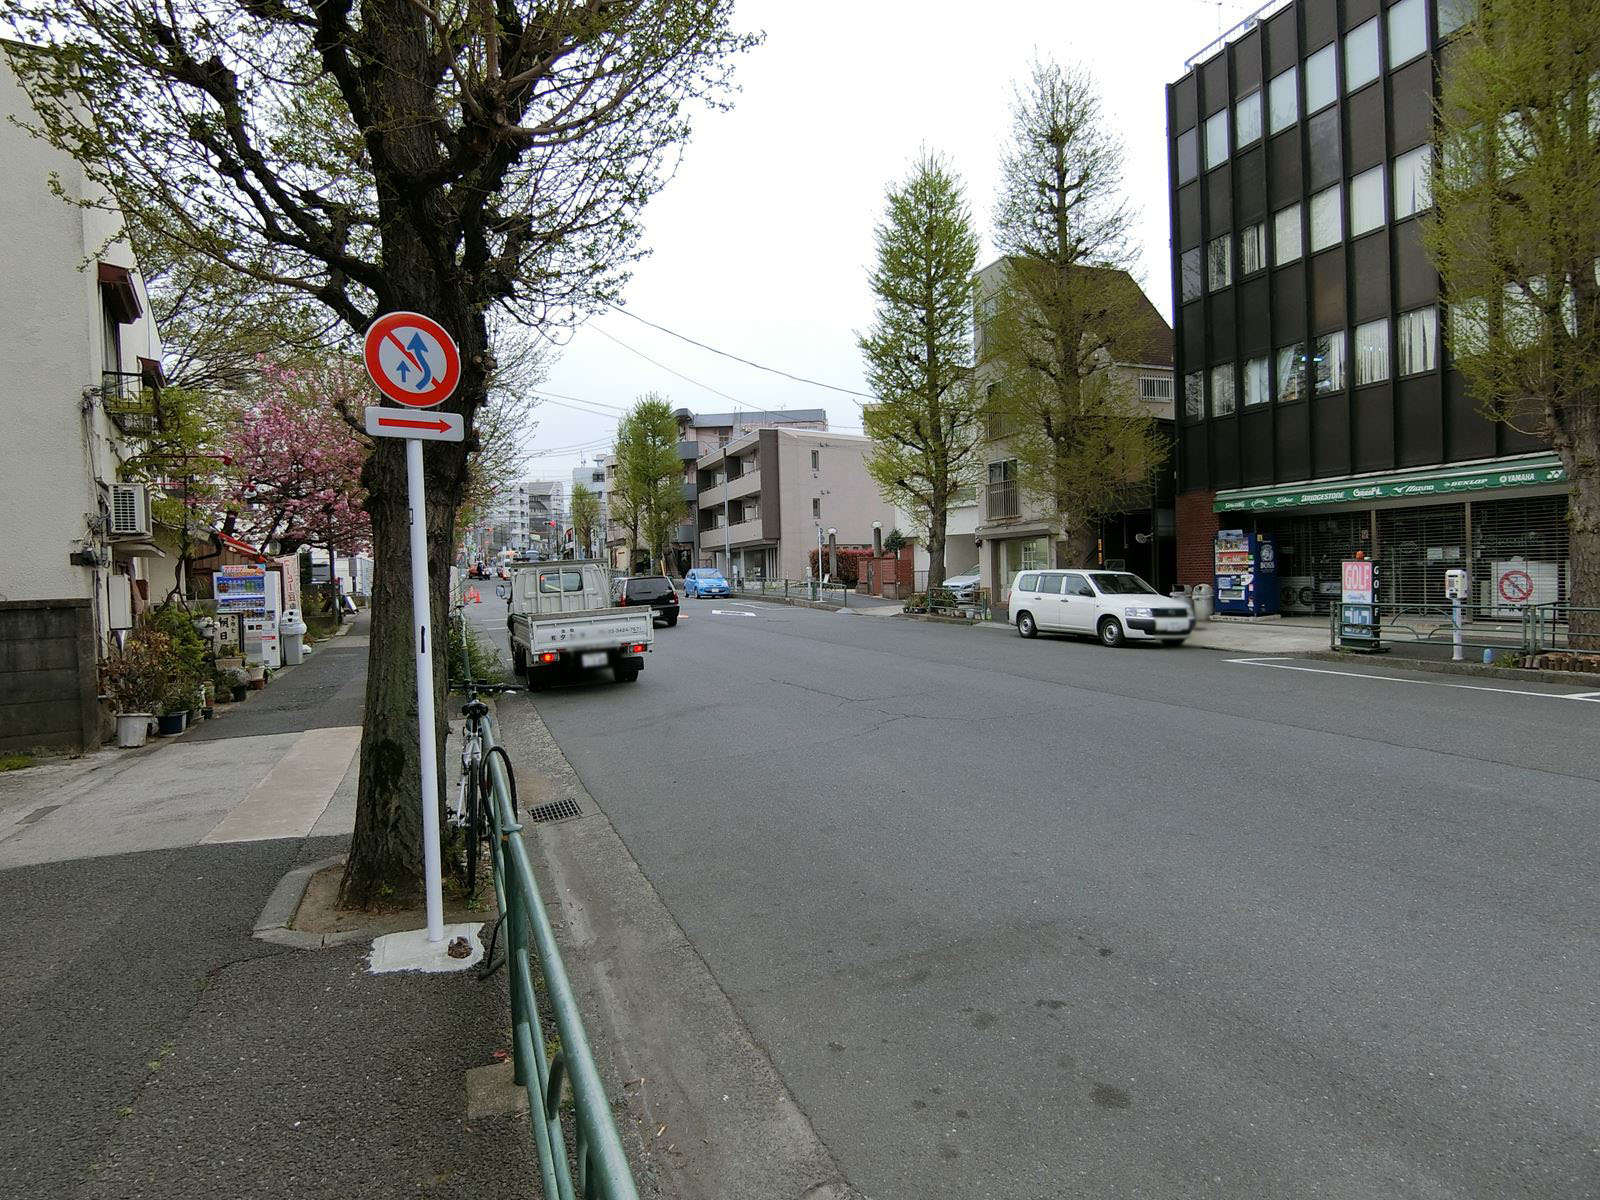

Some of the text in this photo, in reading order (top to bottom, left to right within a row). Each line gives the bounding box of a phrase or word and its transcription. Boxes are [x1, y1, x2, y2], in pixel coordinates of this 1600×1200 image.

[1450, 478, 1488, 487] DUNLOP
[1507, 473, 1535, 482] YAMAHA
[1300, 491, 1344, 502] BRIDGESTONE
[1345, 565, 1370, 589] GOLF
